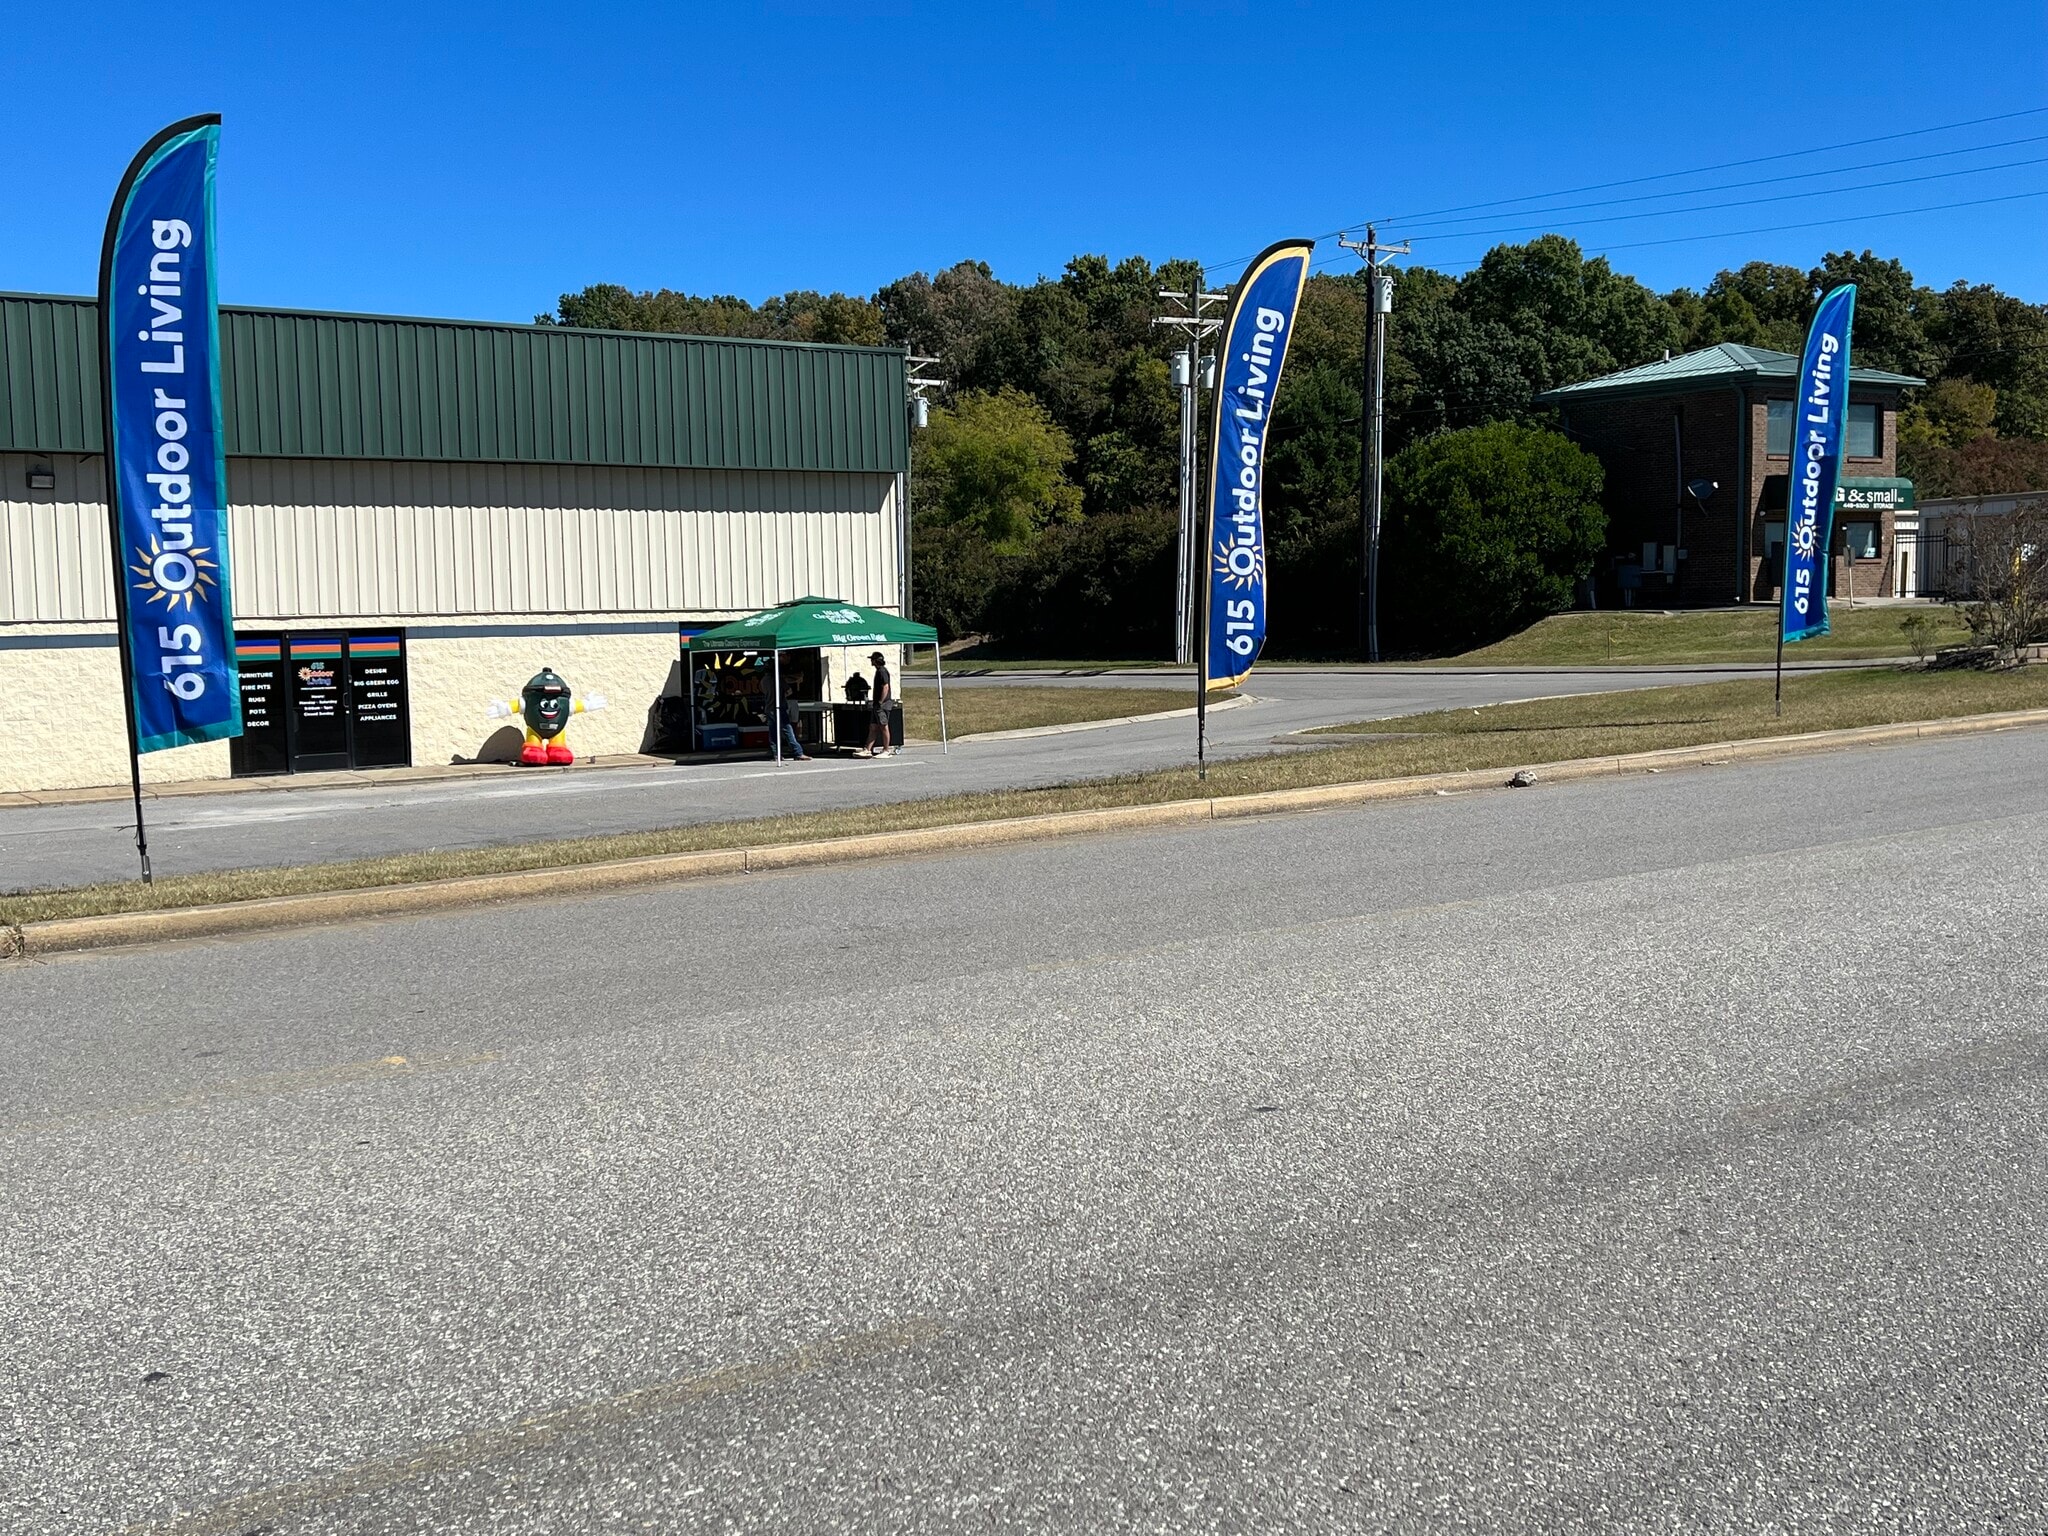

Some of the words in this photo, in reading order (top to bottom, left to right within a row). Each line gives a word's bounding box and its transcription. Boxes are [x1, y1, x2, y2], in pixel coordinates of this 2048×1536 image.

[138, 218, 192, 374] Living
[1236, 306, 1285, 420] Living
[1807, 332, 1839, 425] Living
[147, 389, 196, 592] Outdoor
[1228, 433, 1260, 577] Outdoor
[1799, 433, 1827, 551] Outdoor
[1848, 489, 1865, 502] &
[1867, 488, 1898, 503] small
[1226, 599, 1255, 656] 615
[1794, 568, 1810, 615] 615
[162, 623, 203, 701] 615
[832, 634, 846, 643] Big
[847, 634, 872, 643] Green
